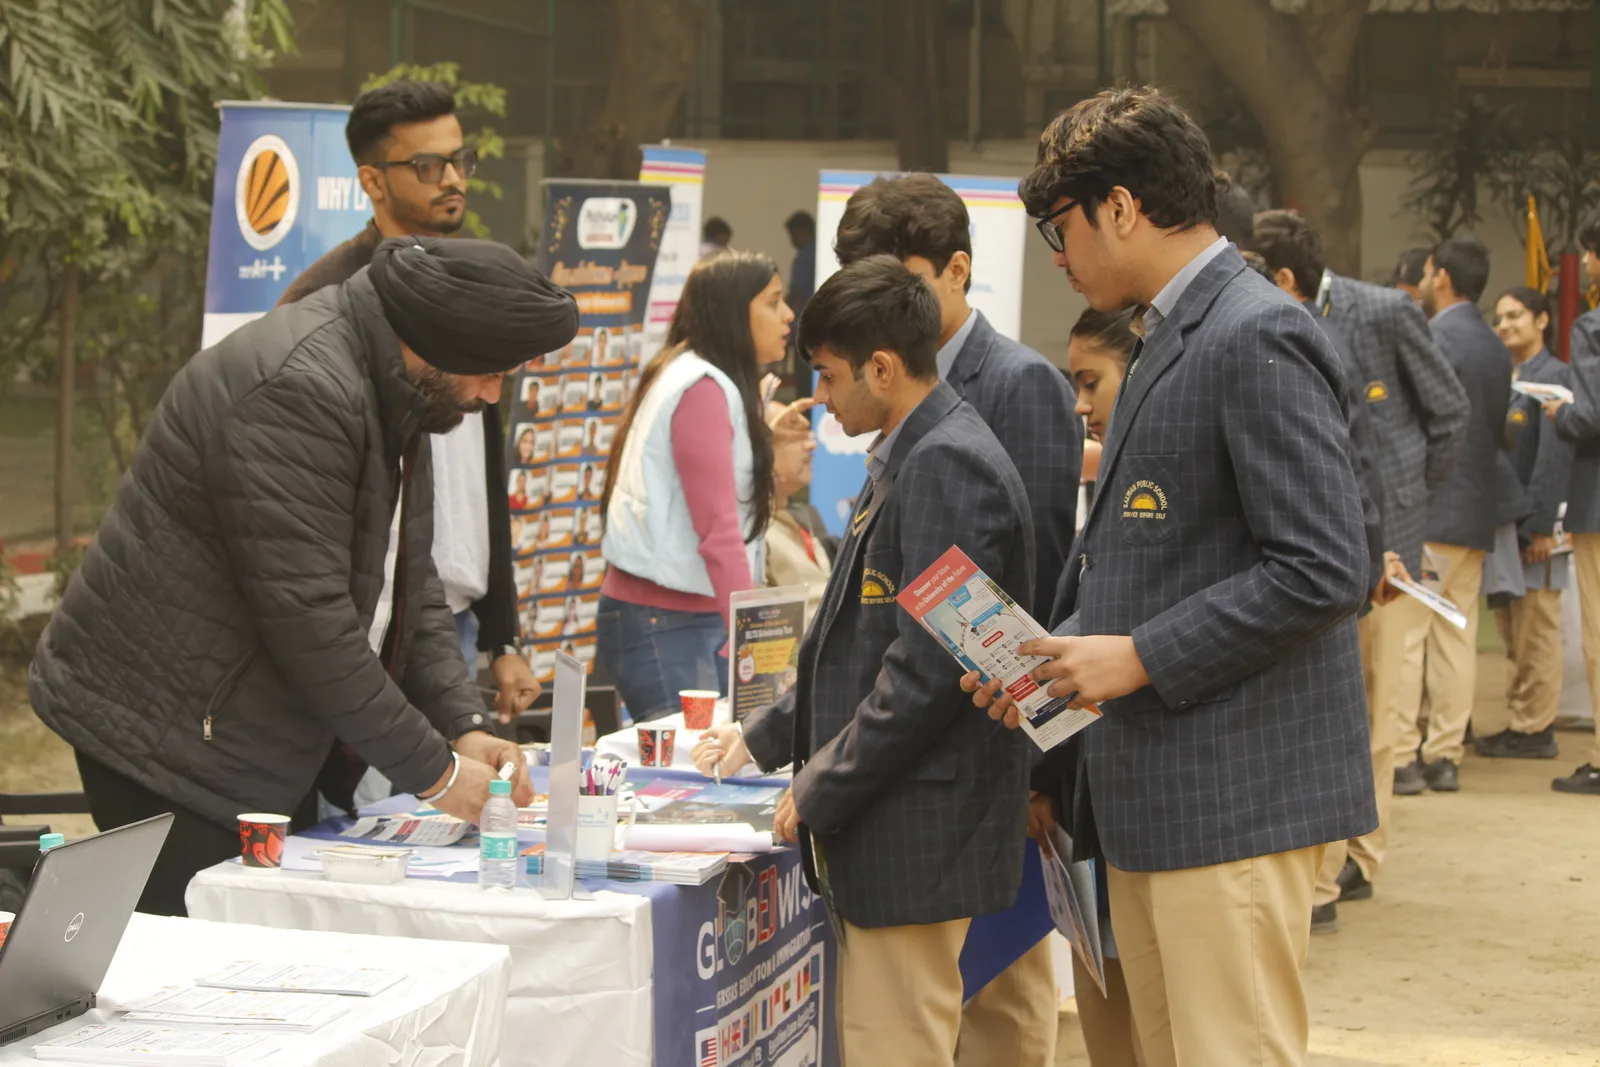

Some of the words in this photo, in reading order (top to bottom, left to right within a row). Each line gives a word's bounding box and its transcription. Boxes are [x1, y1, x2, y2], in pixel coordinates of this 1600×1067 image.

[317, 176, 352, 211] WHY
[1136, 479, 1155, 490] PUBLIC
[1153, 485, 1168, 511] SCHOOL
[1155, 512, 1166, 520] SELF
[876, 571, 896, 594] SCHOOL
